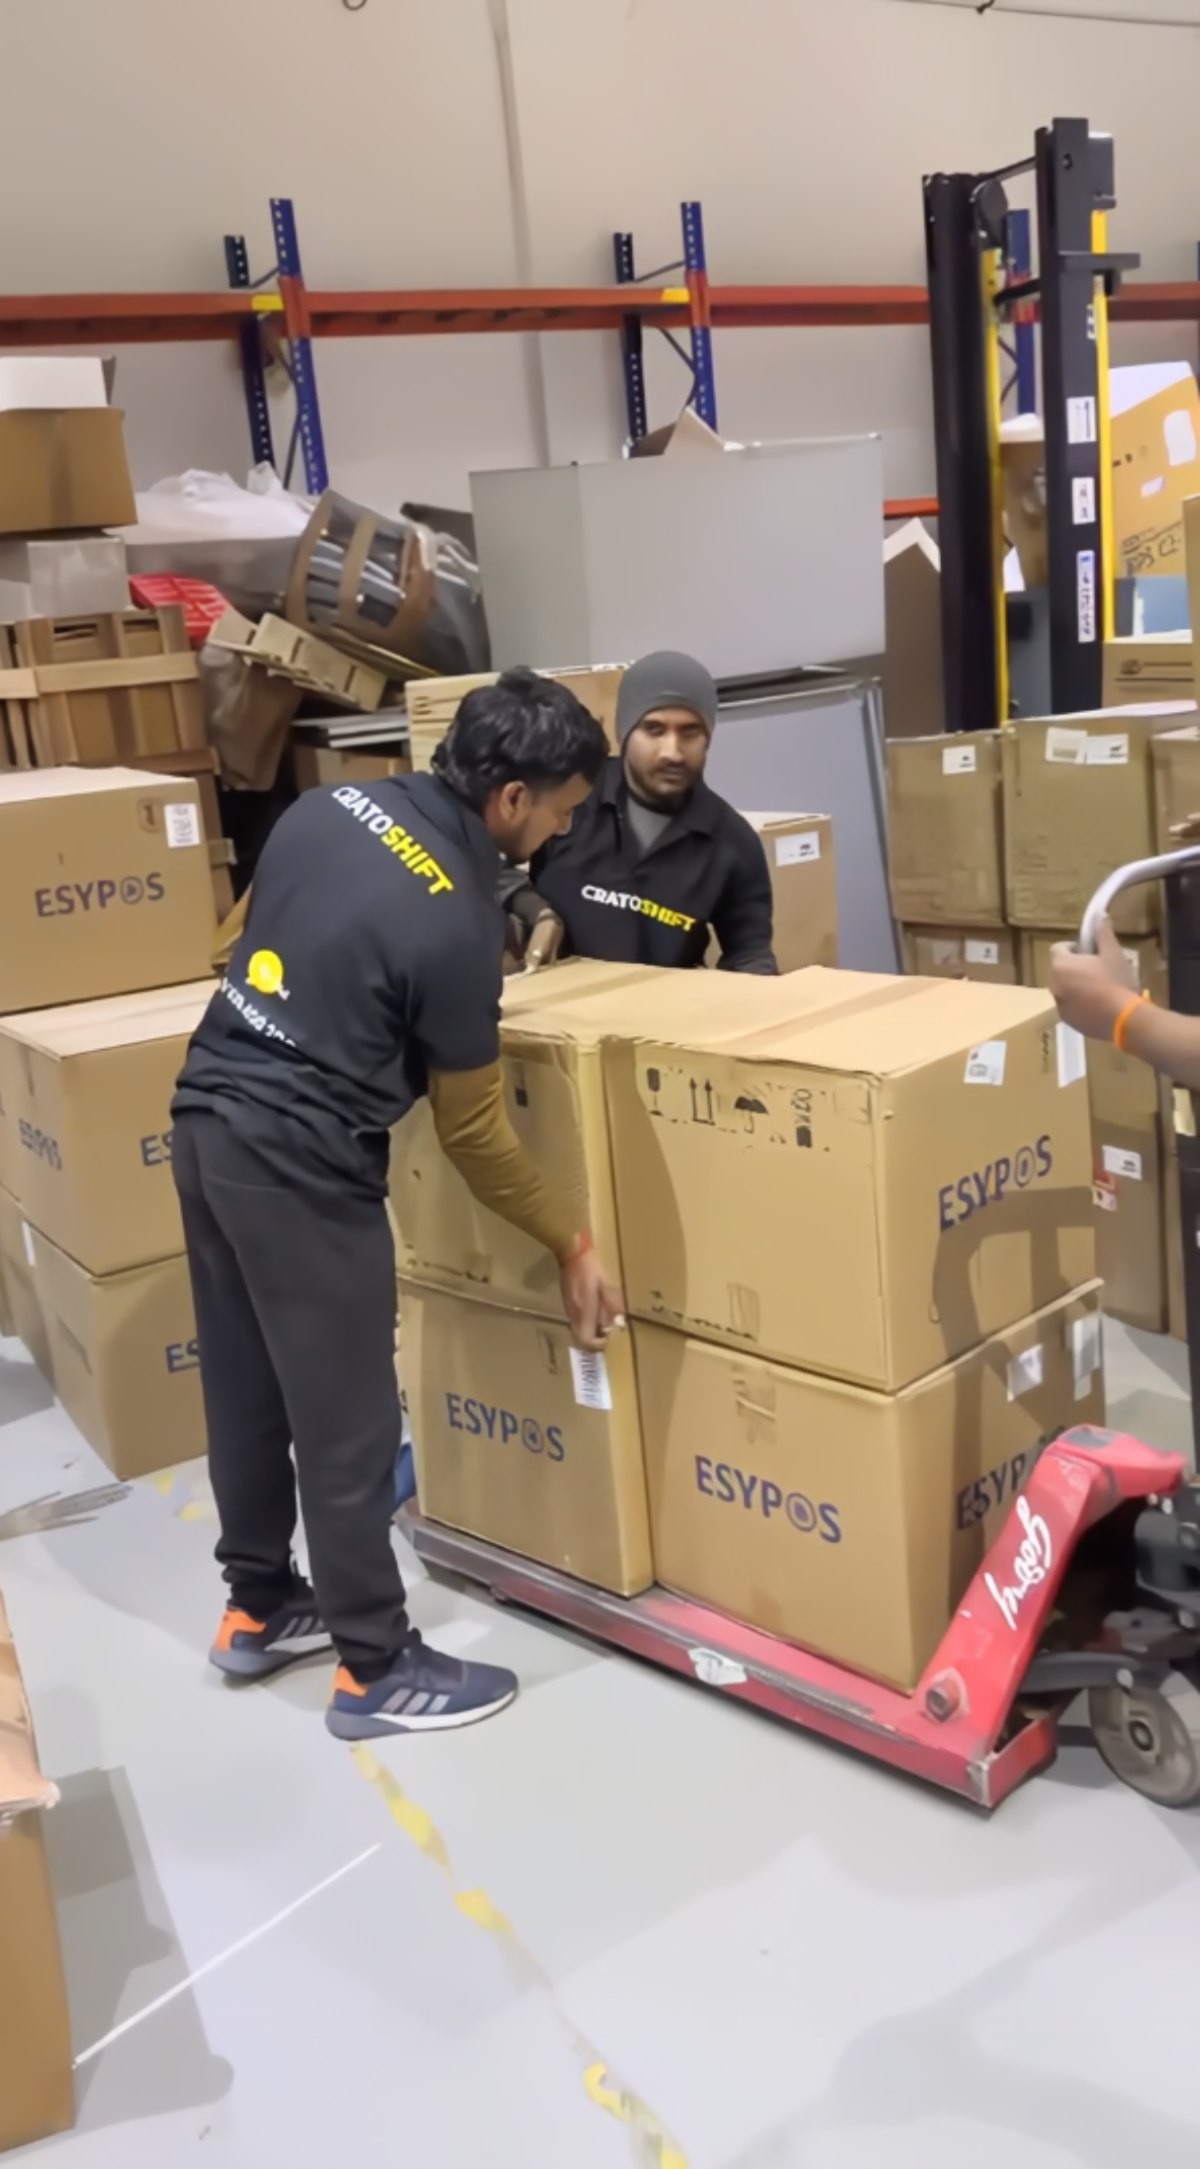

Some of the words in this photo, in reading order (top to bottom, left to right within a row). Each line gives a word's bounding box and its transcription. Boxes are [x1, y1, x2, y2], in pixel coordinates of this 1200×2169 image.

[34, 871, 165, 918] ESYPOS
[938, 1133, 1053, 1232] ESYPOS
[445, 1391, 565, 1462] ESYPOS
[694, 1454, 842, 1544] ESYPOS
